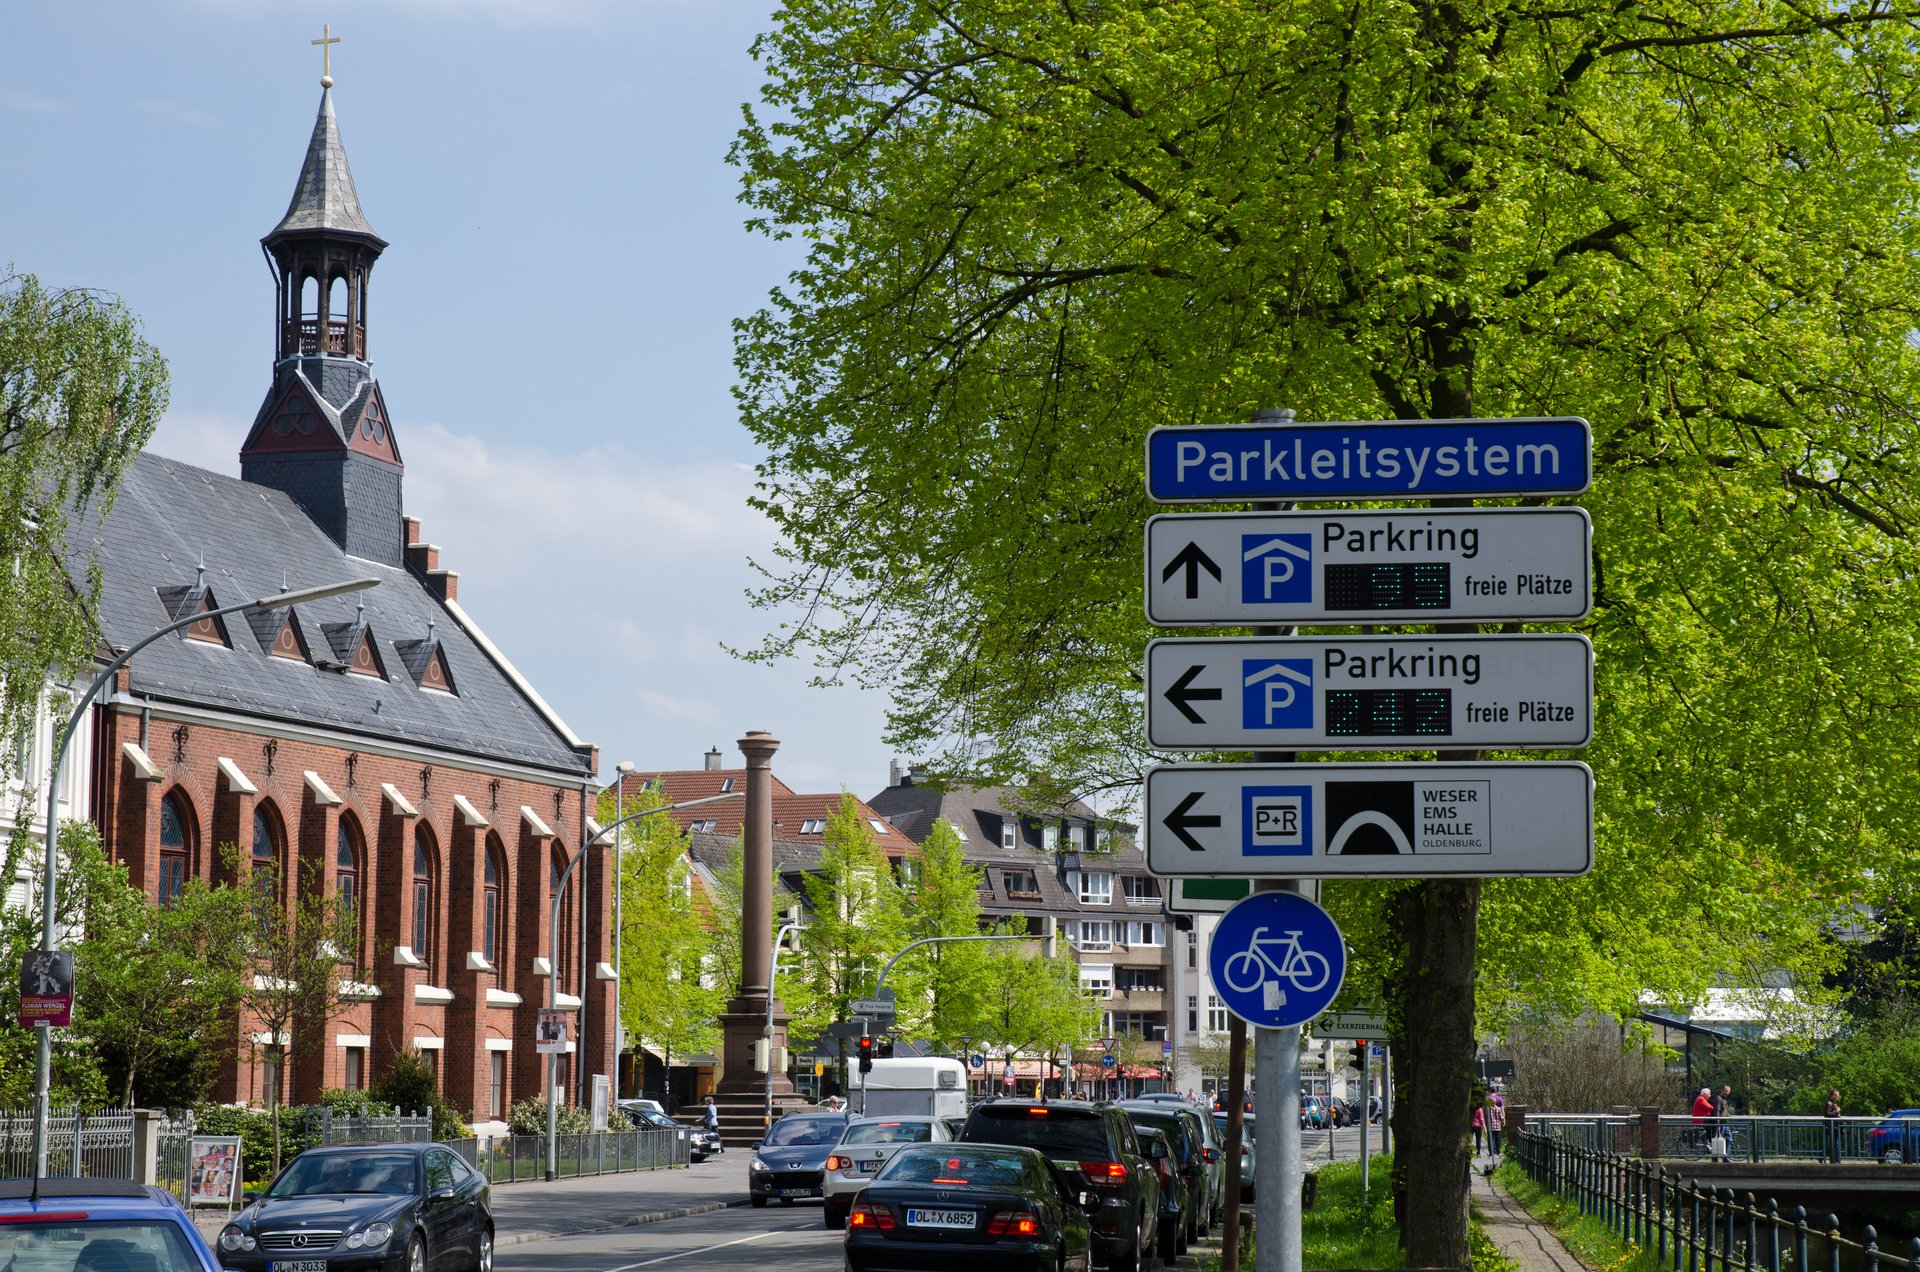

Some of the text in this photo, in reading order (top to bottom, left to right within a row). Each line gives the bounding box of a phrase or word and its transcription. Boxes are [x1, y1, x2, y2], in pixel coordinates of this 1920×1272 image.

[1176, 437, 1560, 489] Parkleitsystem
[1323, 521, 1479, 559] Parkring
[1371, 565, 1444, 608] 95
[1465, 573, 1573, 596] freie Plätze
[1324, 647, 1480, 685] Parkring
[1329, 691, 1445, 734] 242
[1466, 701, 1574, 723] freie Plätze
[1422, 790, 1478, 802] WESER
[1256, 810, 1298, 831] P+R
[1423, 806, 1457, 819] EMS
[1423, 823, 1473, 836] HALLE
[1422, 839, 1482, 848] OLDENBURG
[915, 1211, 974, 1225] OL X 6852
[273, 1261, 326, 1272] OL N 3033
